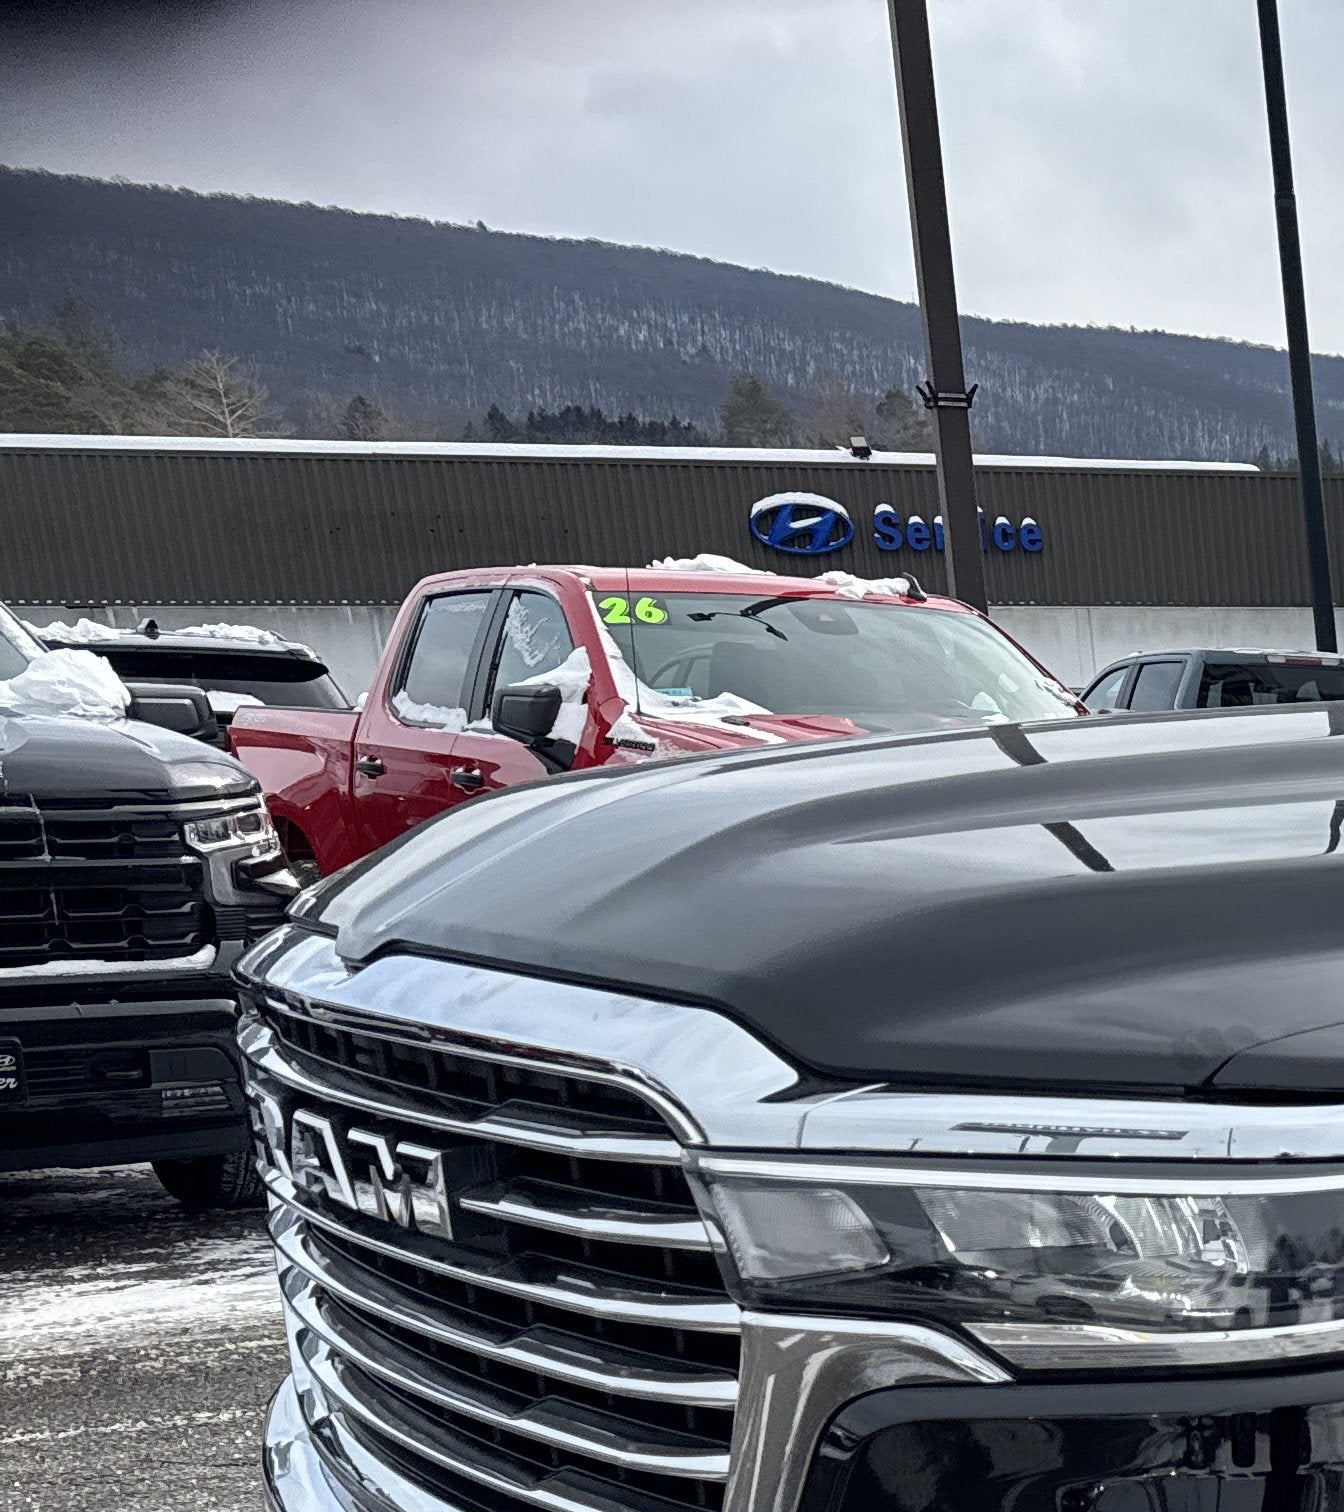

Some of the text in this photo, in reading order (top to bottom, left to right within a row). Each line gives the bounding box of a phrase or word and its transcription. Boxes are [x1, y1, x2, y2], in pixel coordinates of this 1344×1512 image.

[873, 504, 1043, 552] Serice
[599, 597, 667, 624] 26
[249, 1080, 454, 1240] RAM
